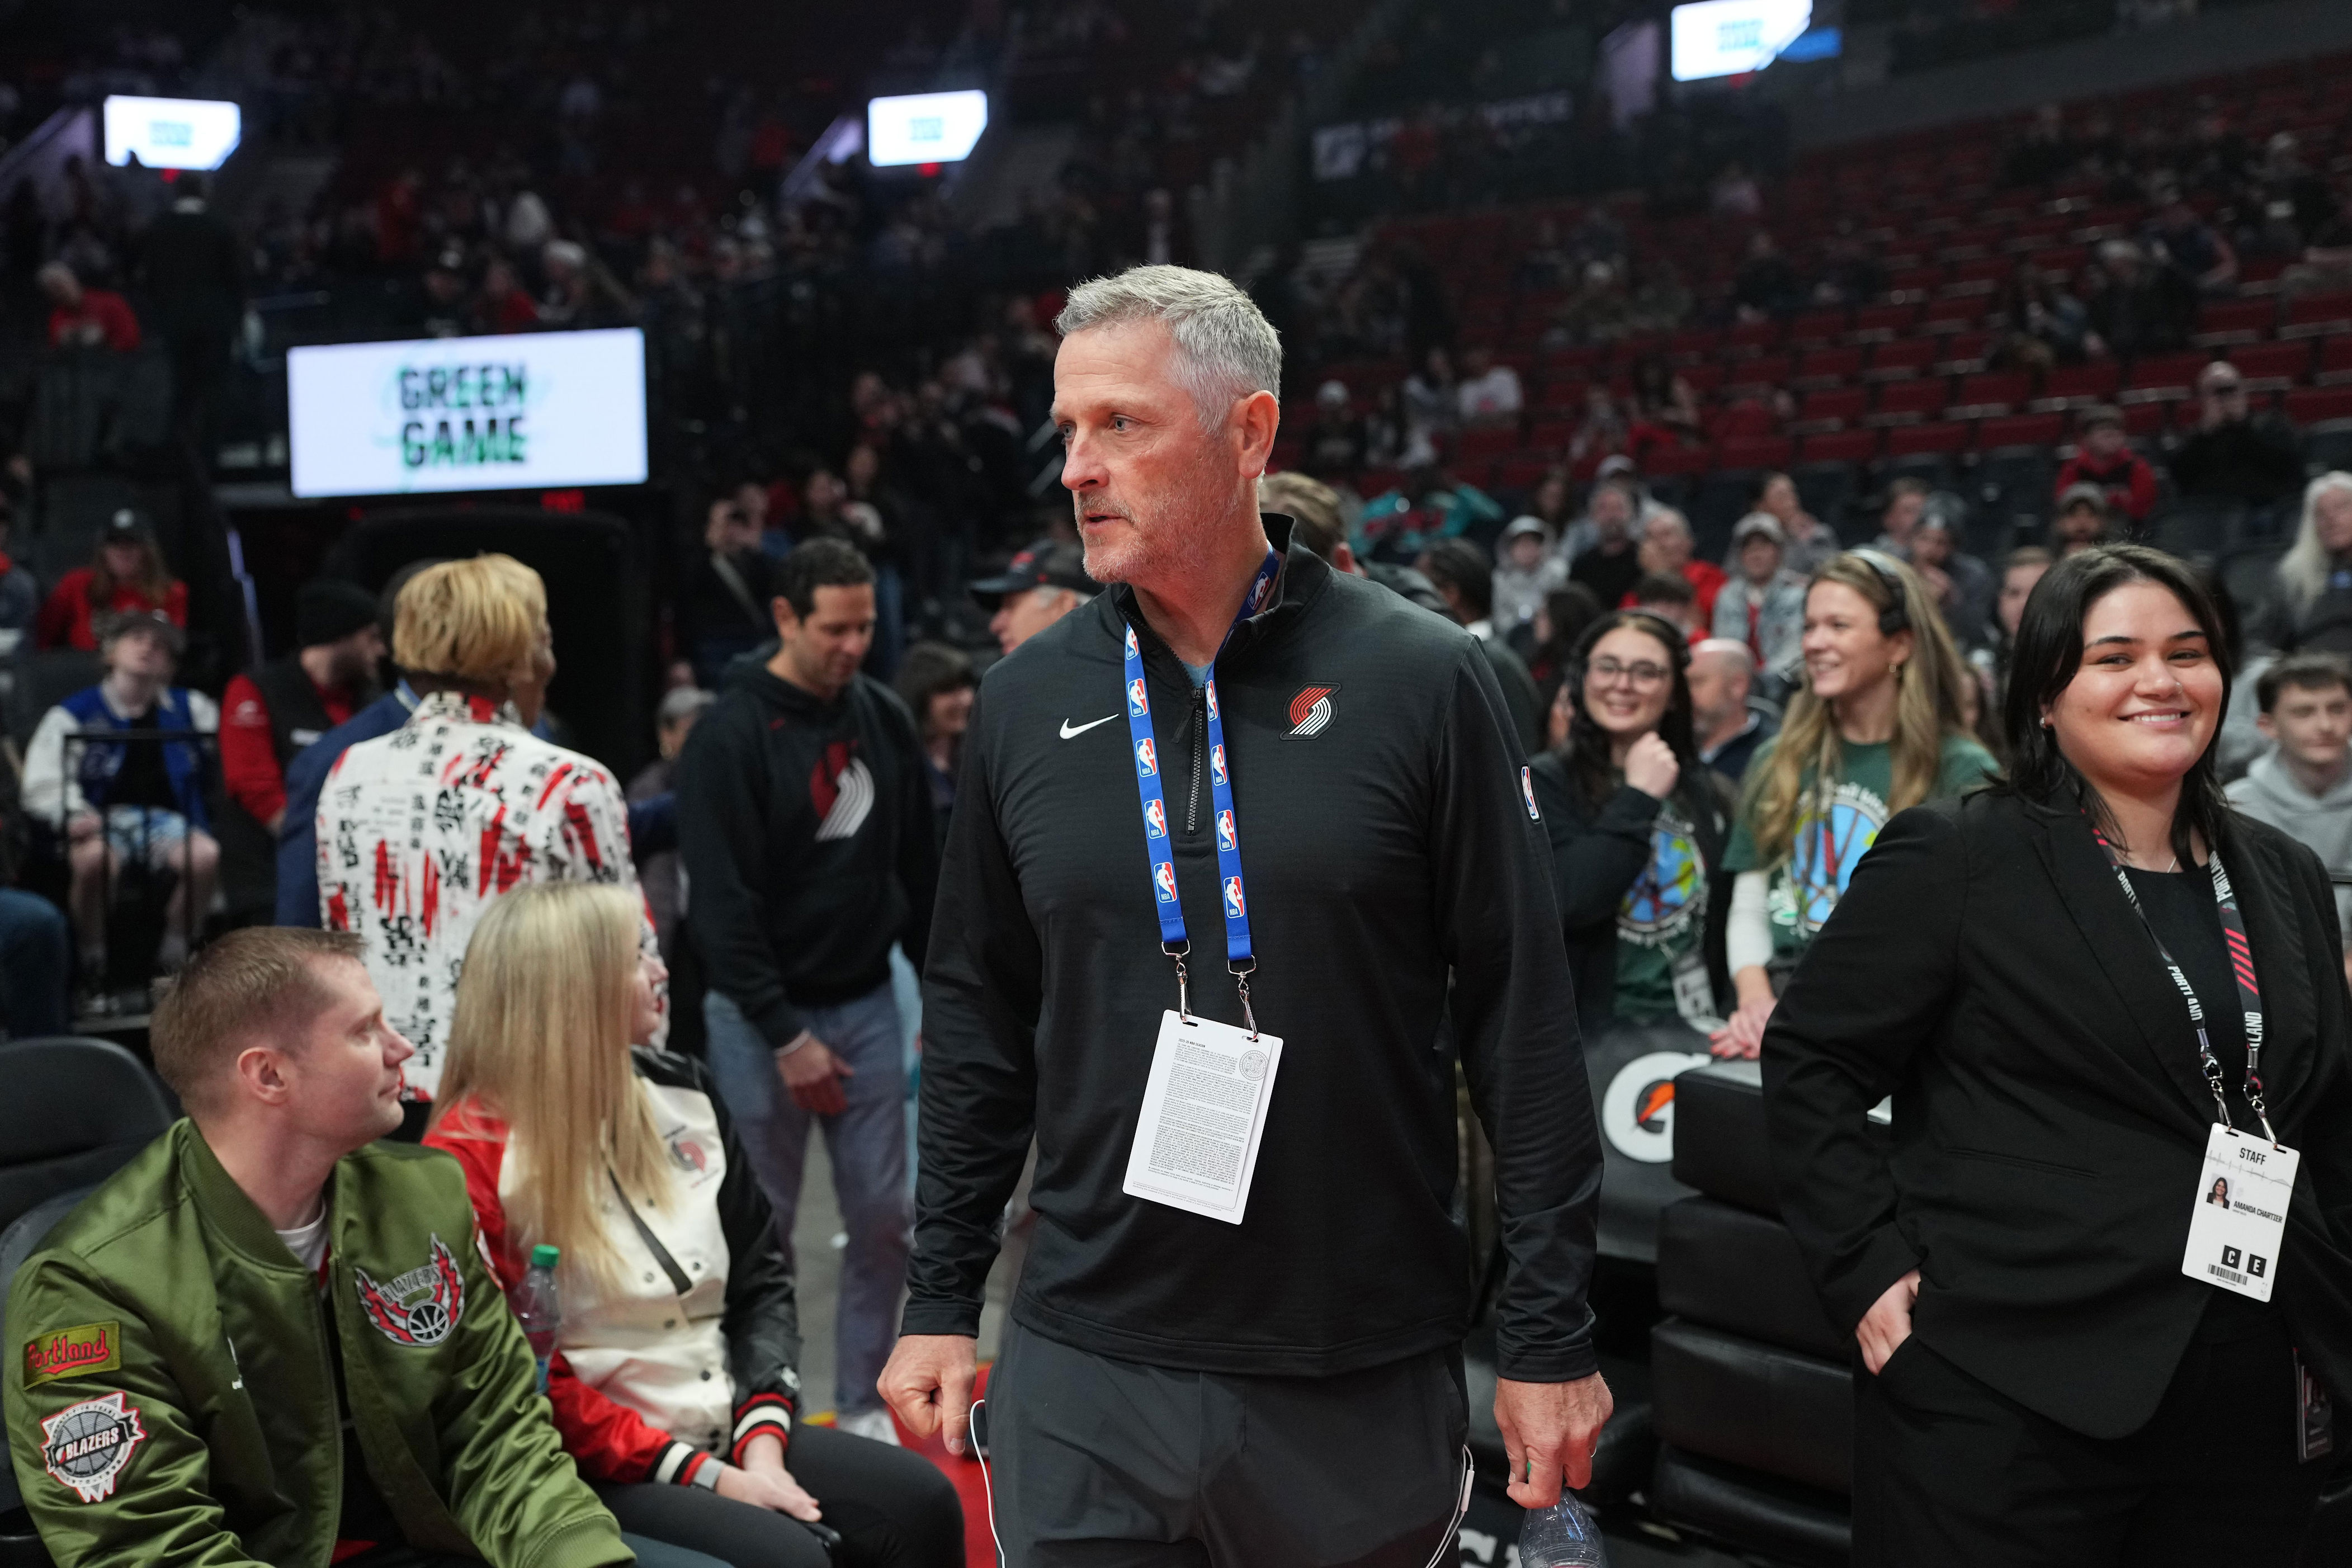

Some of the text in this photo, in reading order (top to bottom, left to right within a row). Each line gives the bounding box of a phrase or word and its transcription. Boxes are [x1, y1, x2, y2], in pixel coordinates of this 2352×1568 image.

[399, 364, 527, 410] GREEN
[402, 416, 526, 468] GAME
[2239, 1147, 2266, 1165] STAFF
[2233, 1201, 2256, 1215] AMANDA
[2256, 1208, 2283, 1223] CHARTIER
[2227, 1250, 2261, 1273] C E
[27, 1328, 110, 1373] Portland
[65, 1427, 120, 1461] BLAZERS
